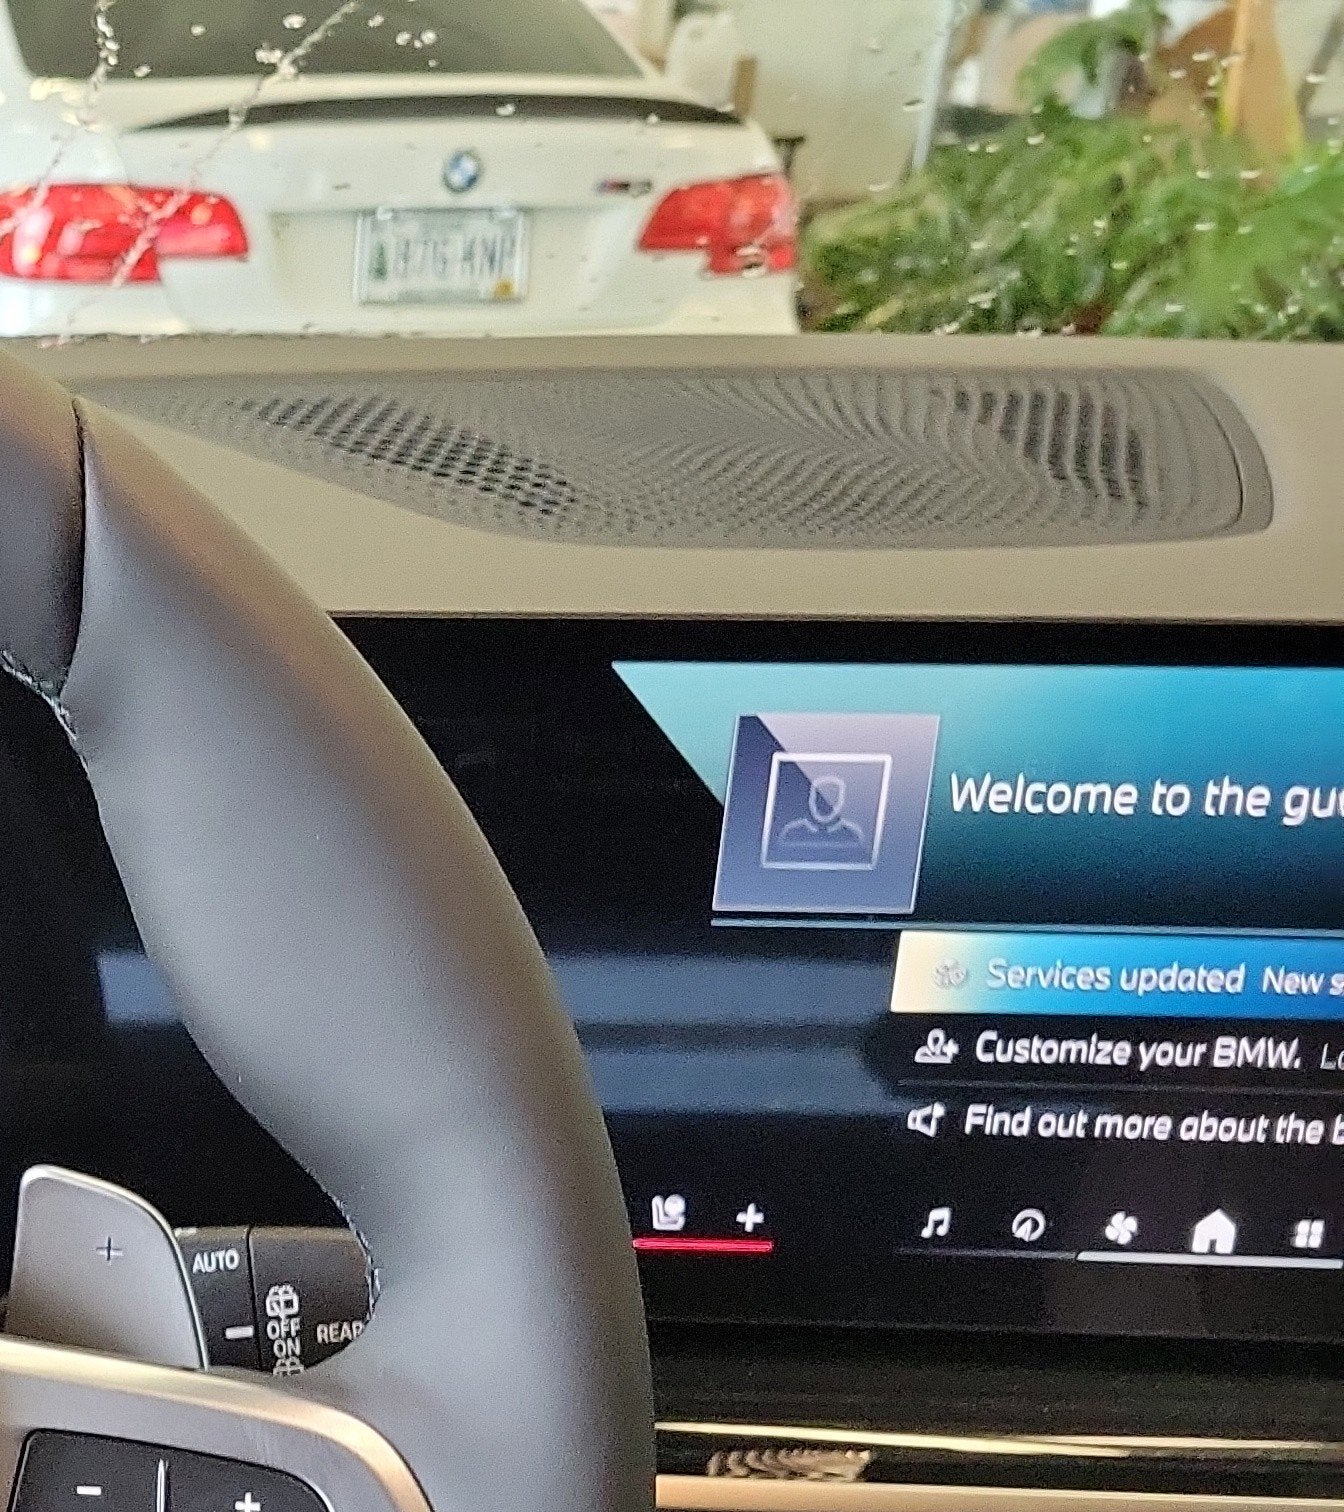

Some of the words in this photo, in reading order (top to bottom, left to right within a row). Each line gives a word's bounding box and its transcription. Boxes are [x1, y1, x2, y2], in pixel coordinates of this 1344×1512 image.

[949, 771, 1138, 815] Welcome
[1150, 777, 1192, 817] to
[1202, 775, 1271, 817] the
[986, 958, 1112, 991] Services
[1120, 961, 1245, 997] updated
[1262, 965, 1324, 995] New
[975, 1029, 1132, 1067] Customize
[1138, 1039, 1207, 1071] your
[1213, 1035, 1302, 1069] BMW.
[964, 1102, 1030, 1138] Find
[1037, 1109, 1088, 1138] out
[1095, 1112, 1173, 1141] more
[1180, 1109, 1269, 1143] about
[1275, 1111, 1326, 1145] the
[192, 1247, 240, 1274] AUTO
[266, 1317, 301, 1341] OFF
[273, 1338, 301, 1358] ON
